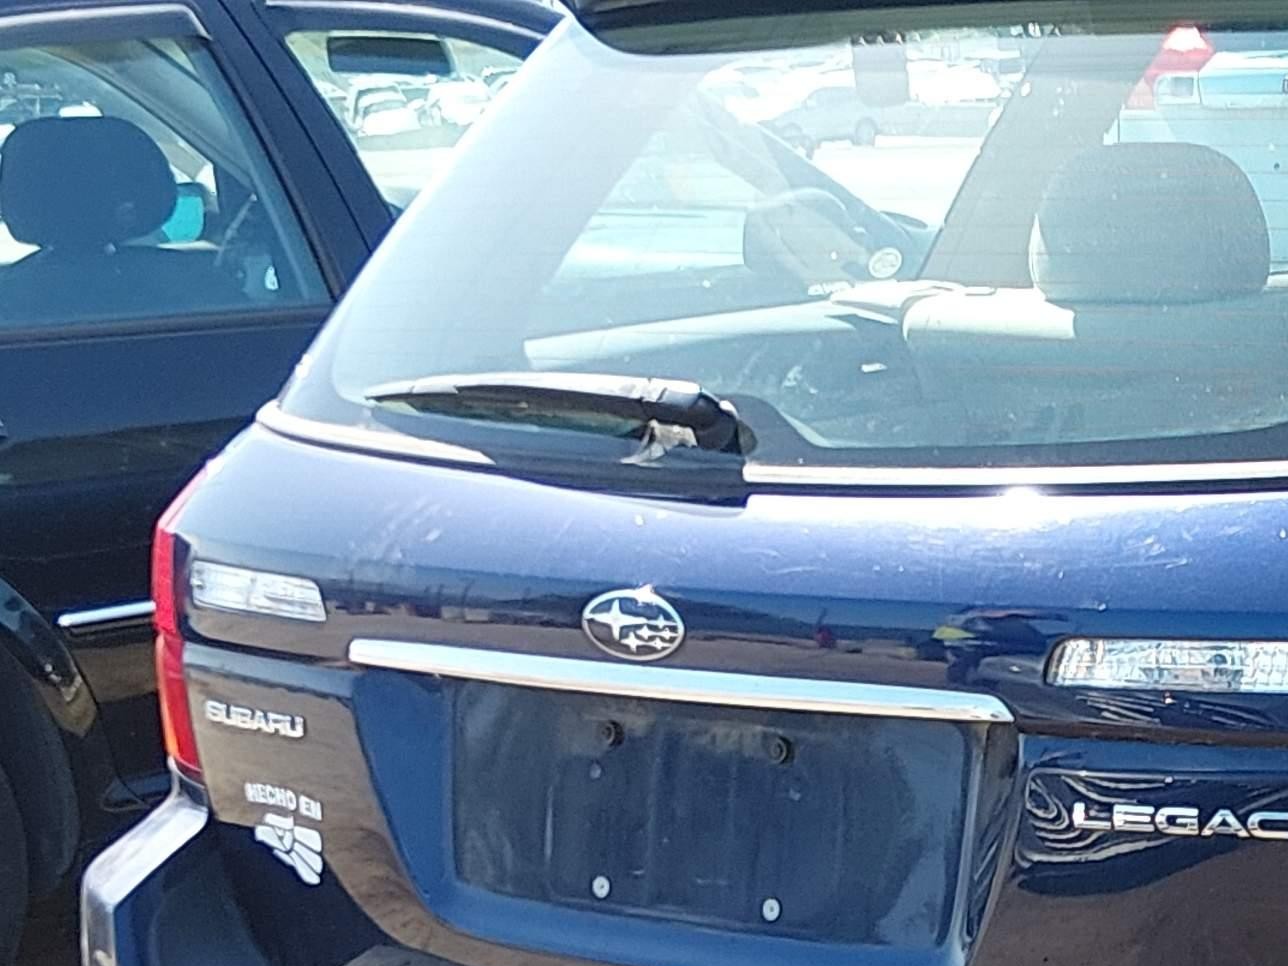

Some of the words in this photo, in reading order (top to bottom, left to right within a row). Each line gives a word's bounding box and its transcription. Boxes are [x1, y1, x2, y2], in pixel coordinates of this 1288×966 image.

[206, 700, 304, 738] SUBARU
[244, 783, 297, 811] HECHO
[300, 795, 322, 821] EN
